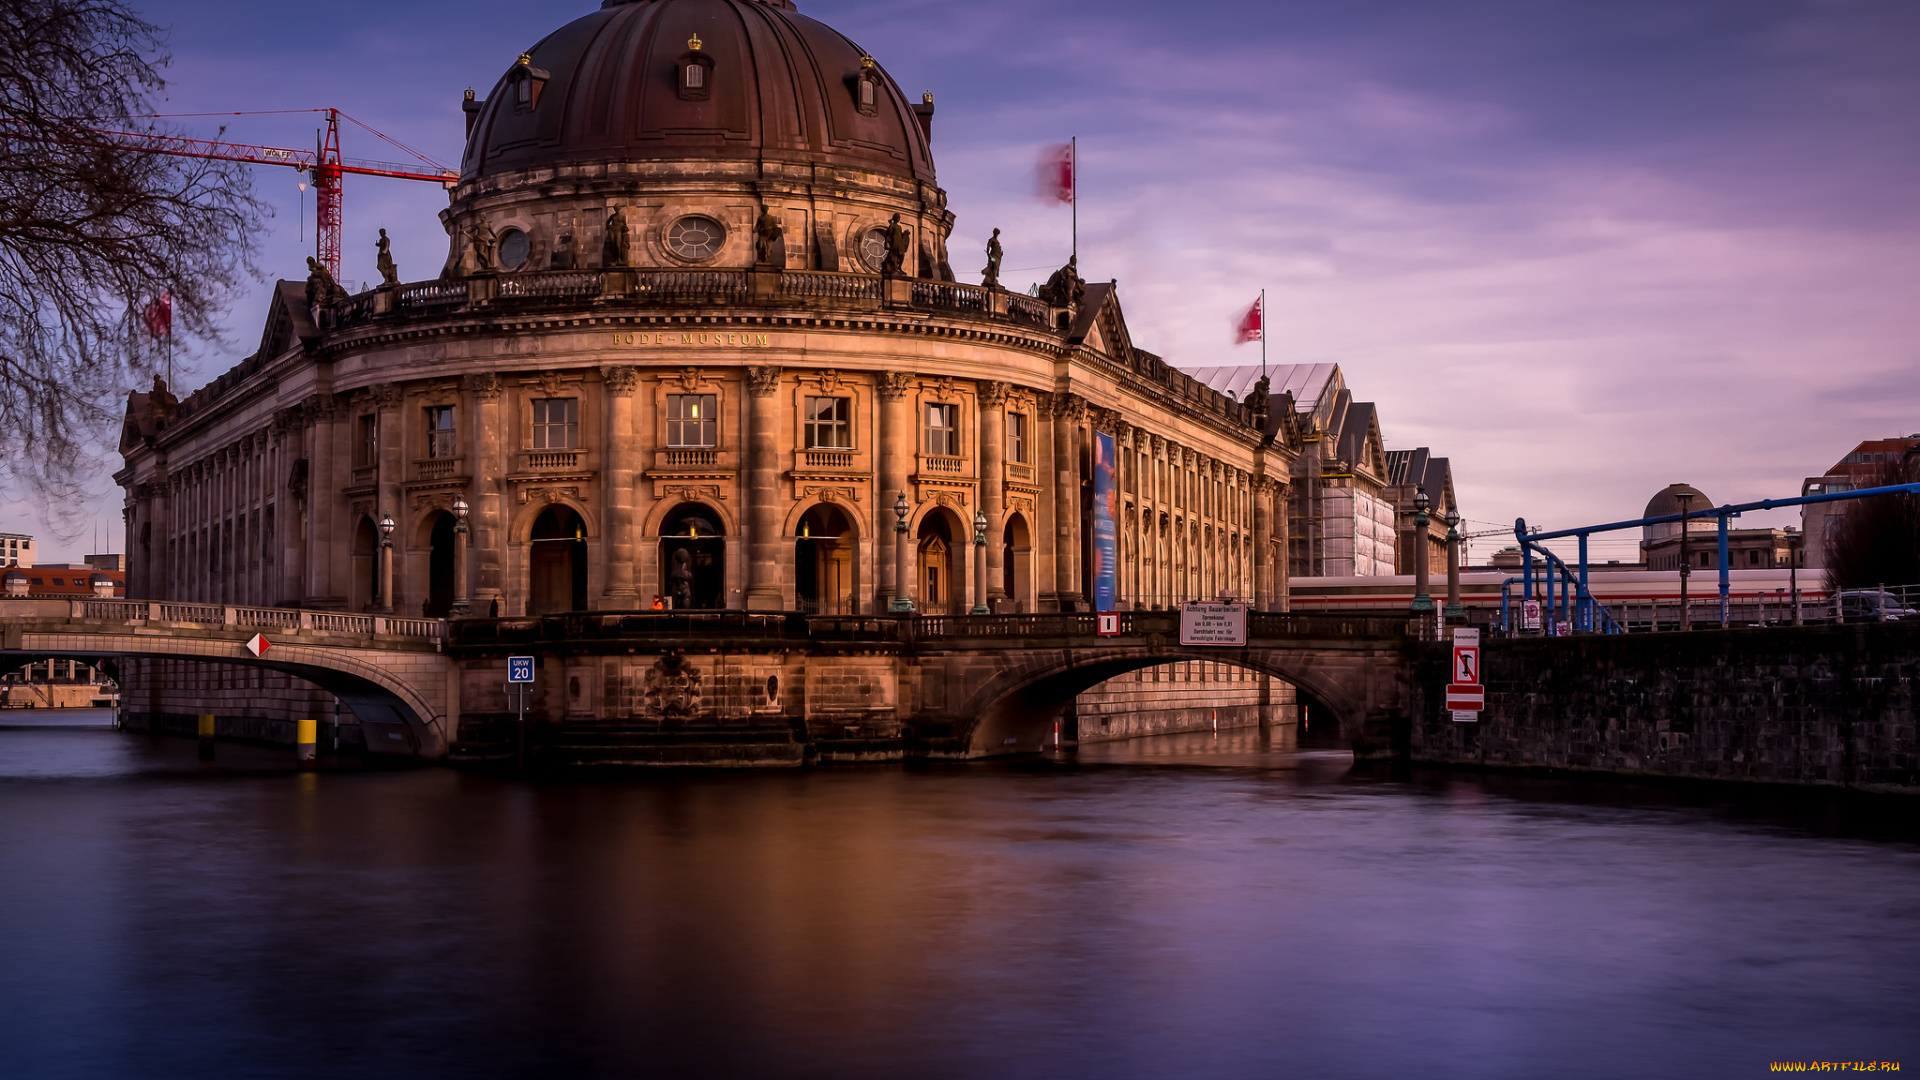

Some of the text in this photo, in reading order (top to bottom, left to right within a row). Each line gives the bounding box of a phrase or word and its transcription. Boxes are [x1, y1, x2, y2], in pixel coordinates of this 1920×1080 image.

[264, 150, 291, 158] WOLFF
[613, 333, 768, 345] BODE-MUSEUM
[514, 667, 529, 679] 20
